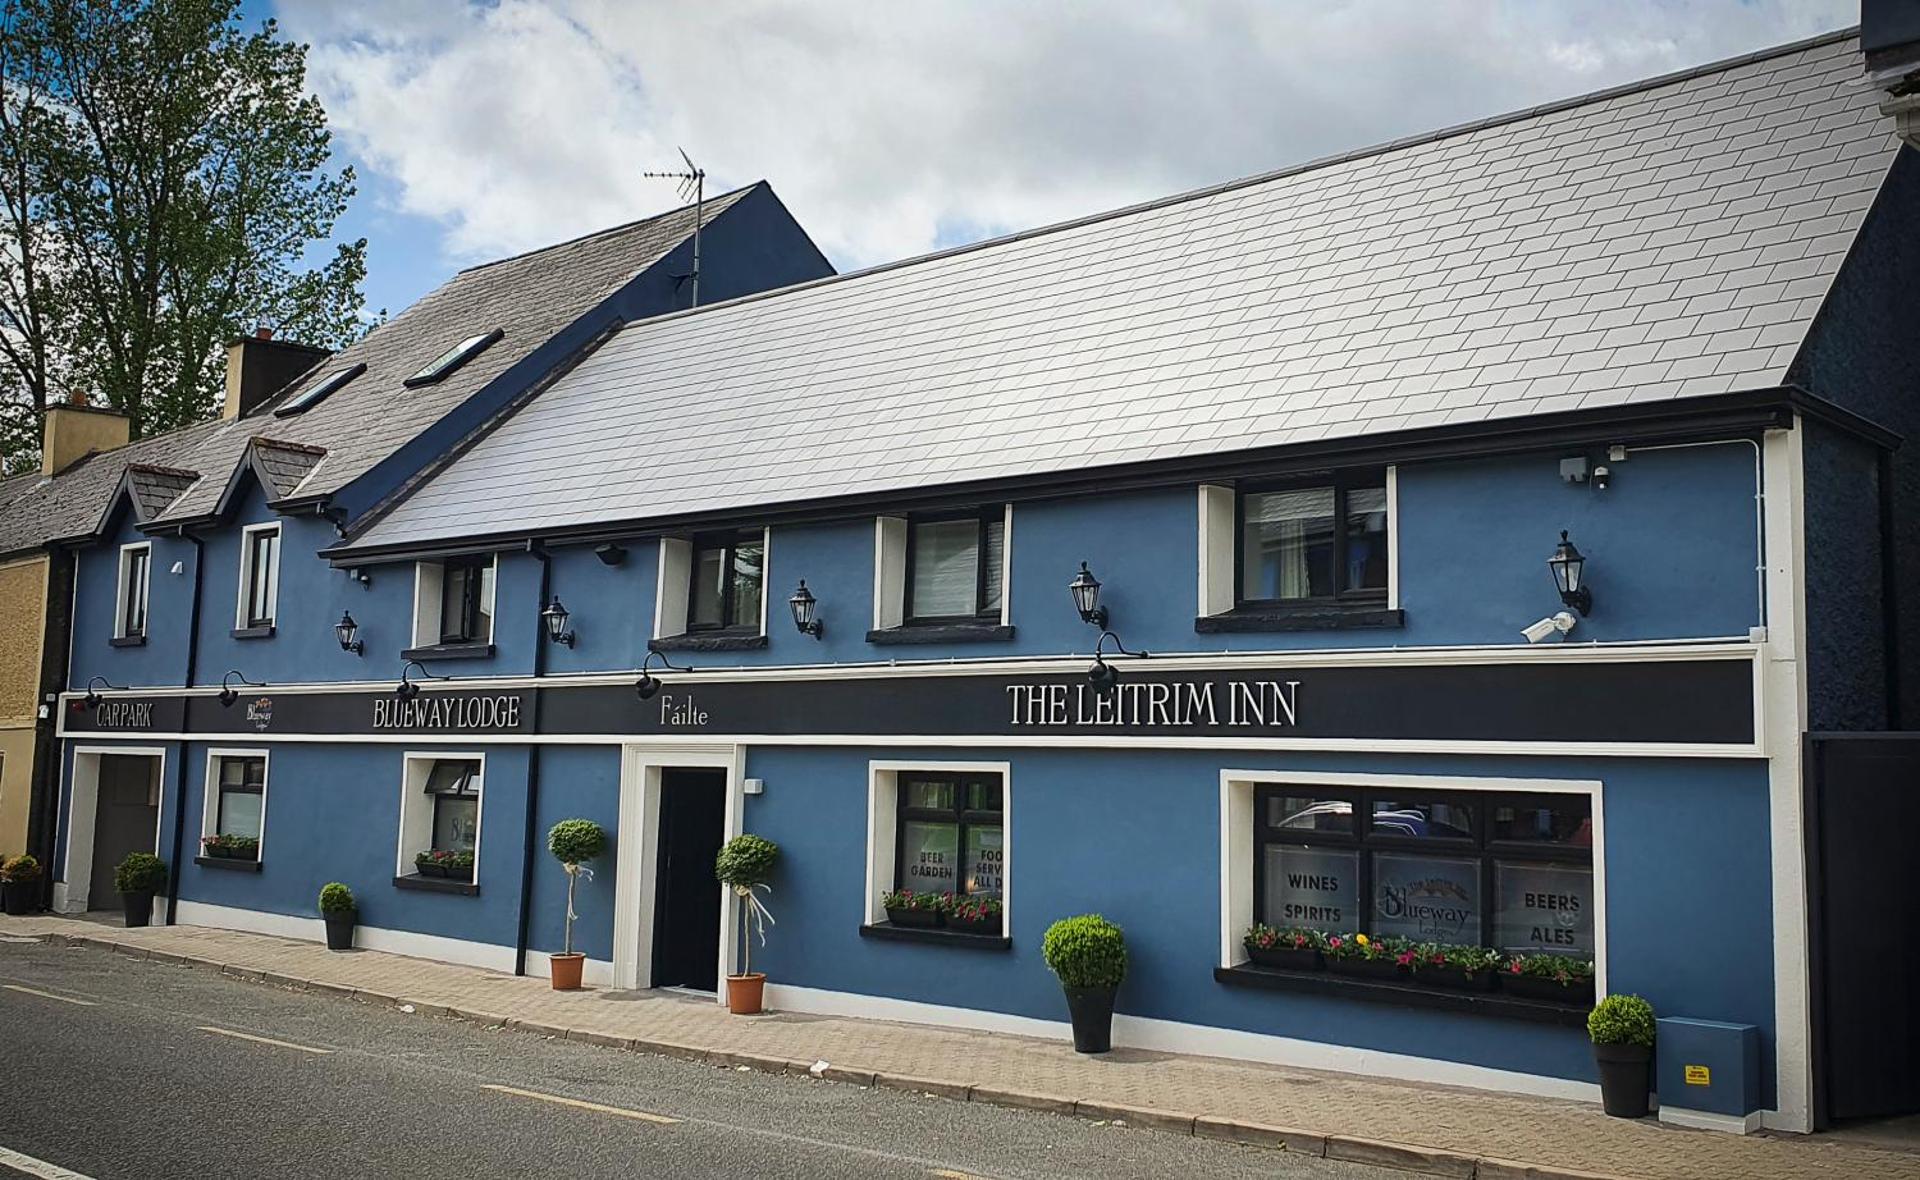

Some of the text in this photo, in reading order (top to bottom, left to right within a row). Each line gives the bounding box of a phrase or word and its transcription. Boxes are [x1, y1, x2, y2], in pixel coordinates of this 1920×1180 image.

[373, 696, 520, 728] BLUEWAY LODGE
[661, 695, 709, 725] Fáilte
[1006, 681, 1300, 726] THE LEITRIM INN
[920, 851, 944, 864] BEER
[911, 865, 952, 878] GARDEN
[973, 875, 992, 888] ALL
[1288, 873, 1339, 892] WINES
[1382, 885, 1472, 928] Blueway
[1525, 892, 1580, 911] BEERS
[1284, 903, 1342, 922] SPIRITS
[1530, 927, 1575, 945] ALES
